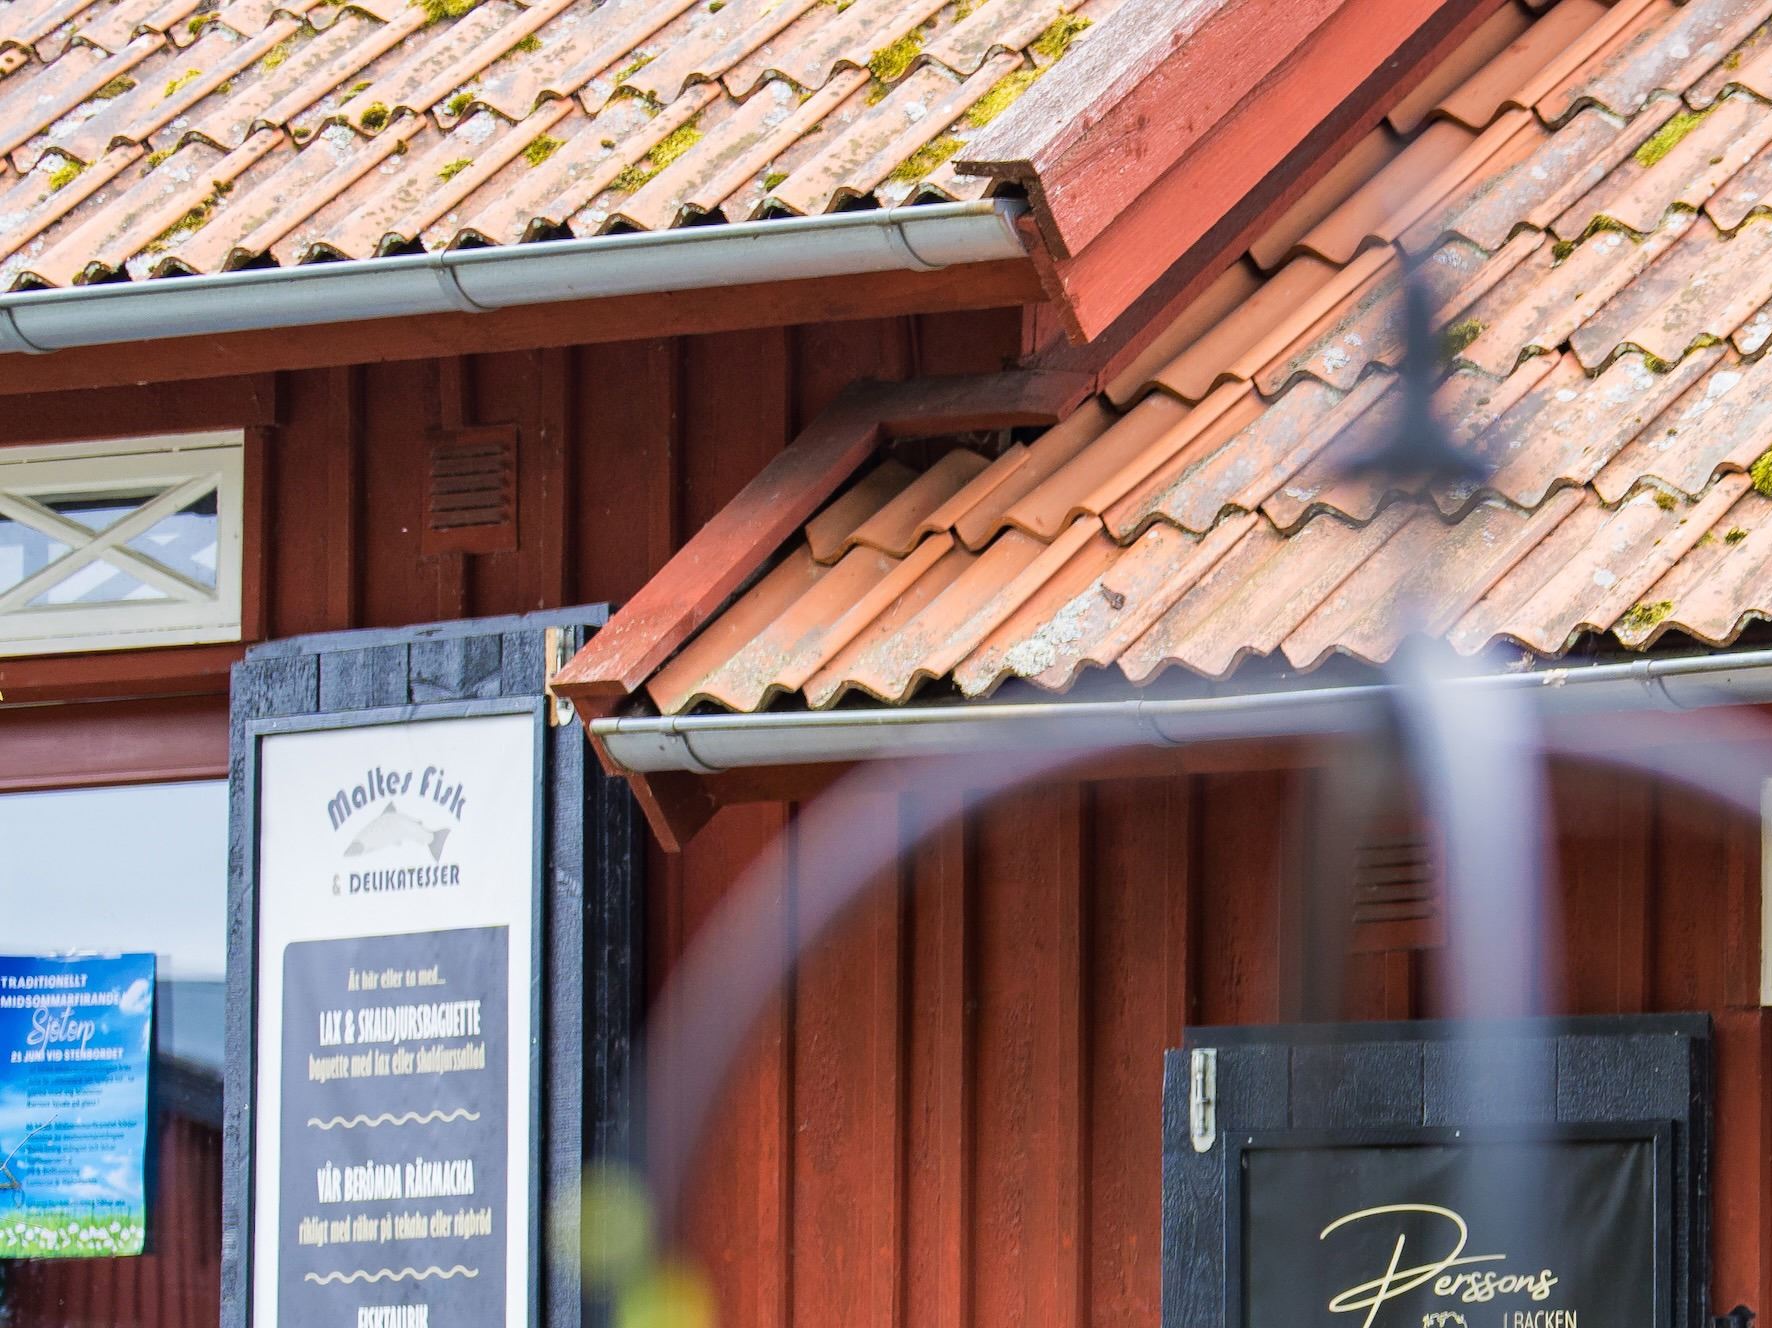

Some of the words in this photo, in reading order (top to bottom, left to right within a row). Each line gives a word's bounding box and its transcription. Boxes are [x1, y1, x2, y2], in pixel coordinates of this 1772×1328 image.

[349, 863, 461, 894] DELIKATESSER
[0, 973, 88, 990] TRADITIONELLT
[319, 1009, 342, 1047] LAX
[344, 1008, 356, 1044] &
[358, 999, 481, 1045] SKALDJURSBAGUETTE
[307, 1052, 349, 1084] baguette
[350, 1048, 373, 1077] med
[374, 1047, 390, 1077] lax
[391, 1046, 415, 1075] eller
[316, 1159, 343, 1204] VÅR
[344, 1159, 403, 1202] BERÖMDA
[404, 1156, 475, 1199] RÄKMACKA
[330, 1213, 352, 1244] med
[353, 1212, 379, 1242] räkor
[380, 1210, 393, 1244] på
[430, 1207, 453, 1239] eller
